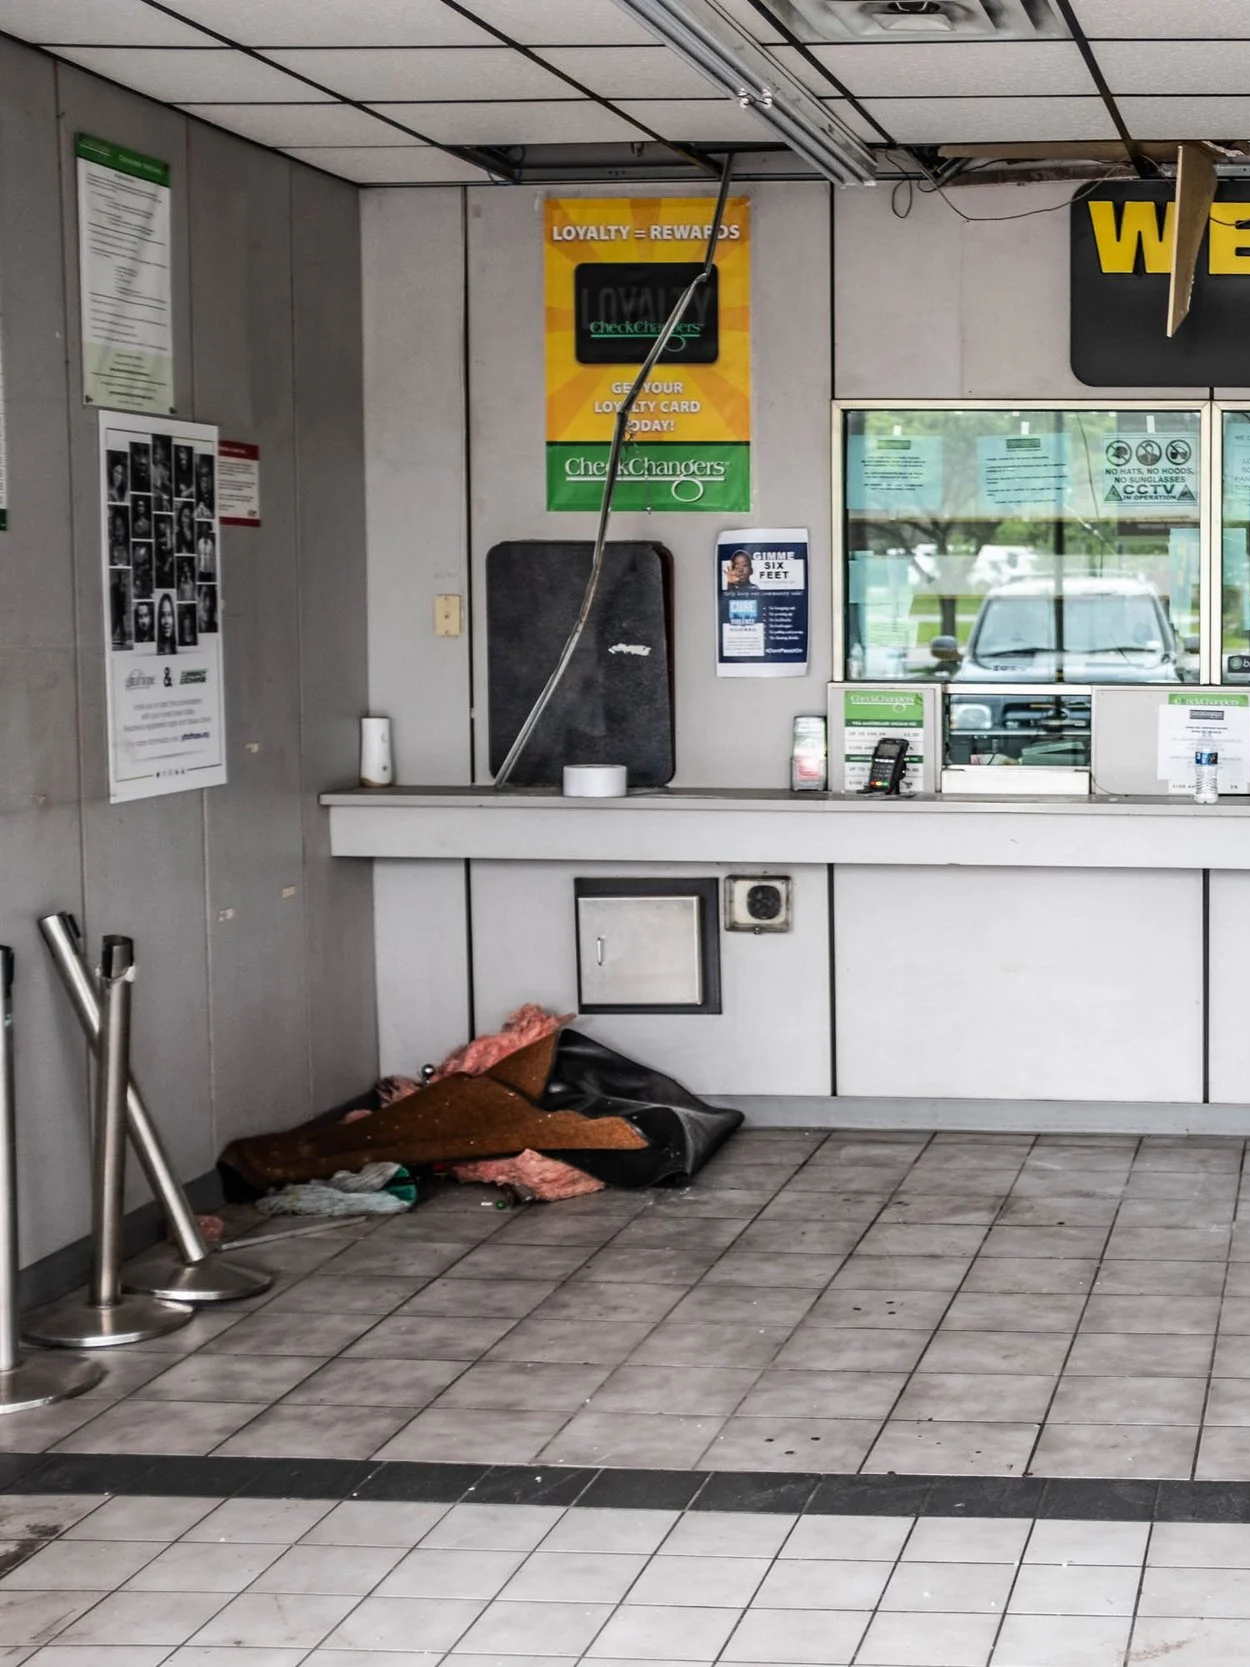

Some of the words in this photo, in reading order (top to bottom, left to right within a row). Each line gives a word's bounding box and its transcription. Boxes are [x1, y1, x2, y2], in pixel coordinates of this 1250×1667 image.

[552, 225, 630, 240] LOYALTY
[650, 224, 740, 240] REWARDS
[644, 382, 684, 394] YOUR
[594, 400, 655, 413] LOYLTY
[660, 400, 701, 413] CARD
[625, 419, 675, 432] ODAY!
[1123, 484, 1175, 495] CCTV
[753, 551, 796, 561] GIMME
[764, 561, 784, 570] SIX
[759, 571, 790, 579] FEET
